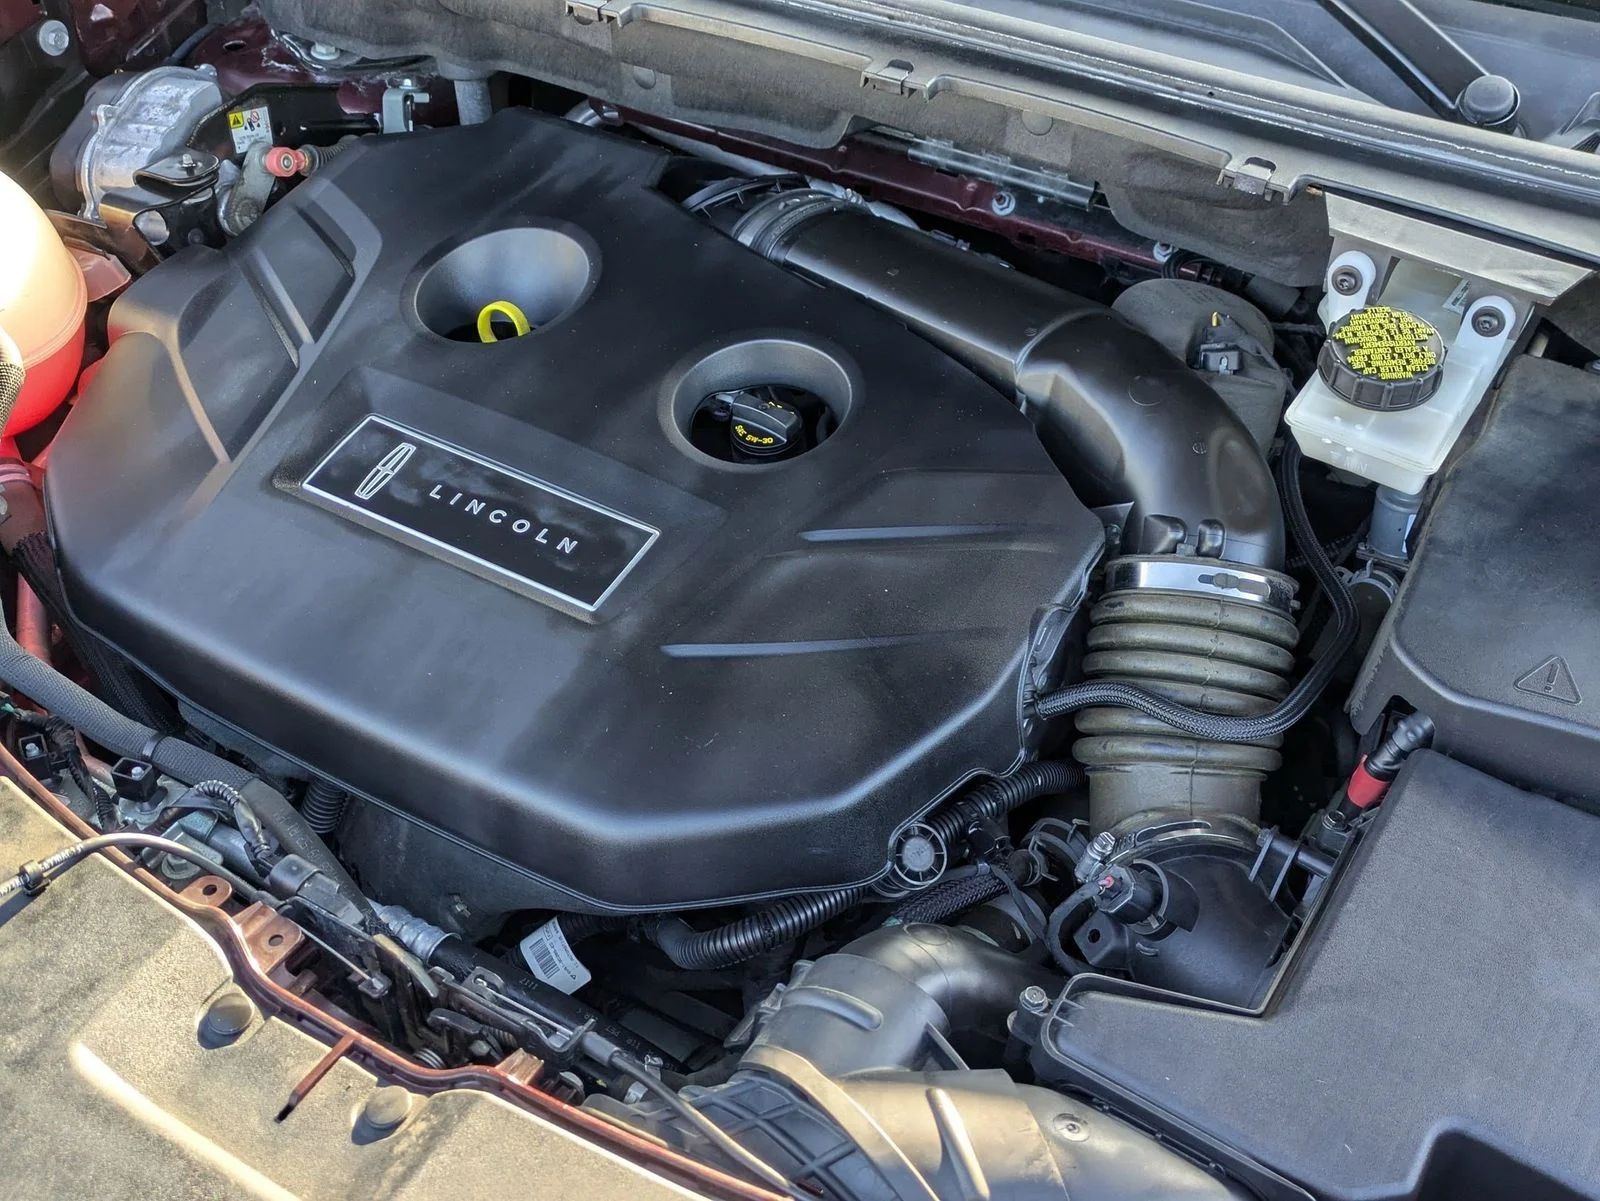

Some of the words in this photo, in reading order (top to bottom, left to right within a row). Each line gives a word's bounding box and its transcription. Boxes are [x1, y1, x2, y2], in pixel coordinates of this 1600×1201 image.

[1395, 346, 1421, 354] SEALED
[1370, 353, 1391, 361] FLUID
[1419, 351, 1436, 359] ONLY
[1352, 361, 1366, 369] USE
[1409, 358, 1435, 366] BEFORE
[1362, 367, 1377, 375] CAP
[1380, 365, 1404, 373] FILLER
[745, 434, 774, 444] 5W-30
[429, 484, 579, 555] LINCOLN
